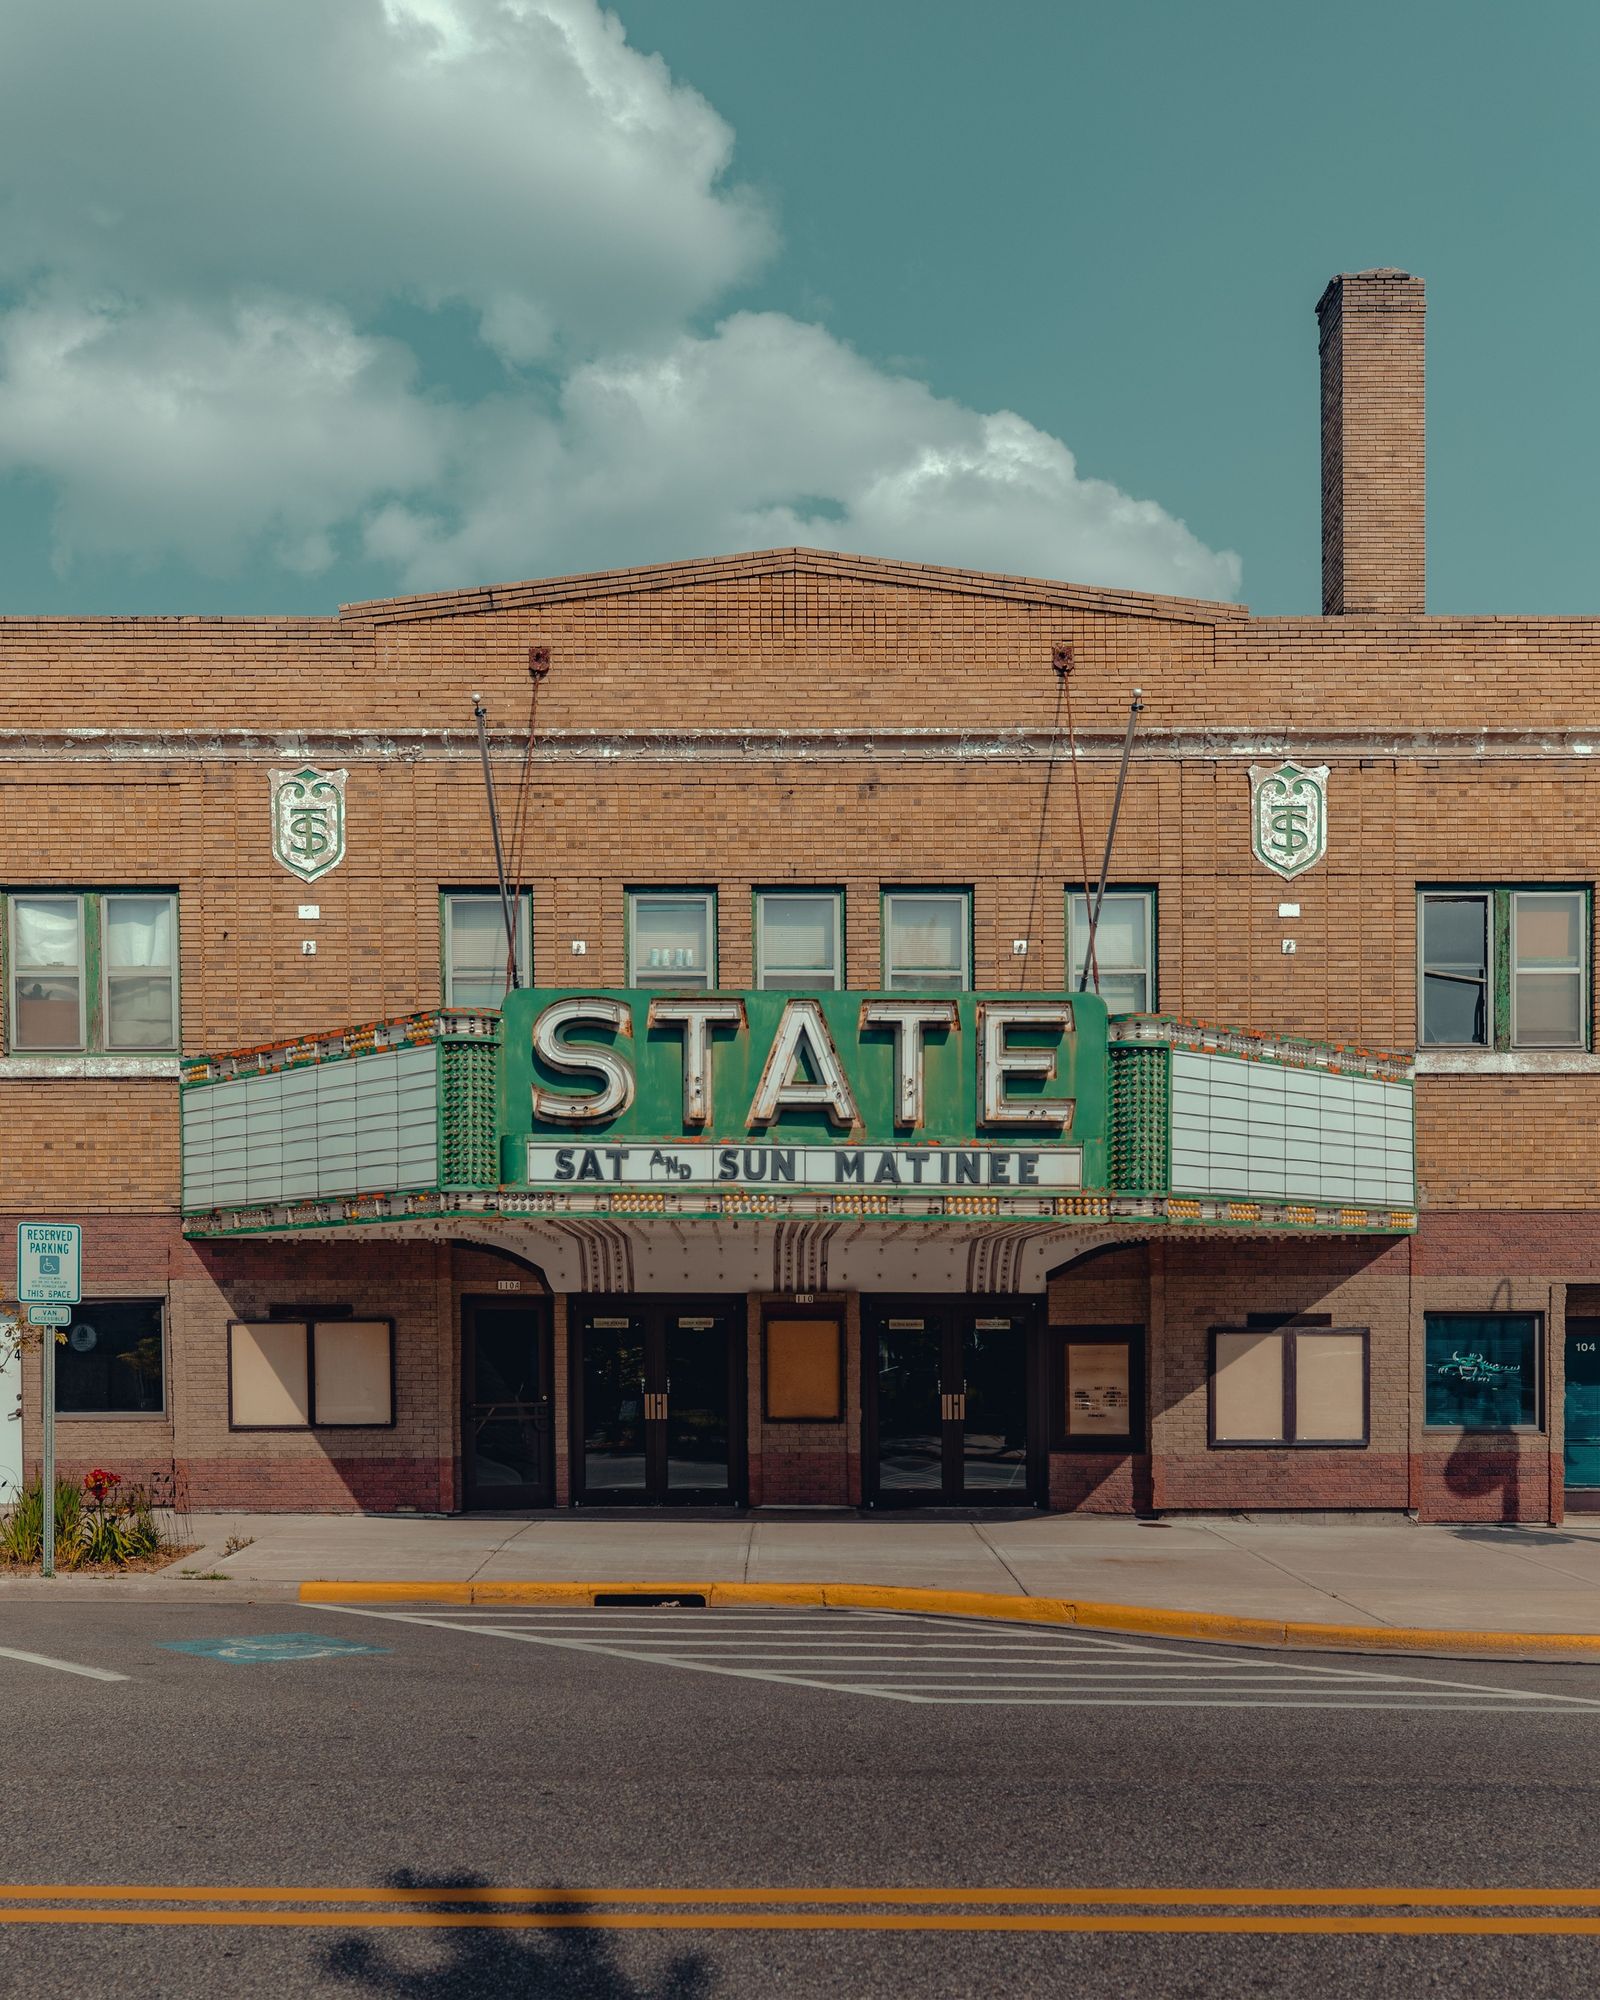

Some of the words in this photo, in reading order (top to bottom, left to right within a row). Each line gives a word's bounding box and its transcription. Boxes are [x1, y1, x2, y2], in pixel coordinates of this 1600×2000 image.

[531, 996, 1077, 1130] STATE
[554, 1149, 629, 1181] SAT
[649, 1149, 692, 1181] AND
[718, 1149, 796, 1181] SUN
[834, 1151, 1040, 1184] MATINEE
[27, 1229, 73, 1242] RESERVED
[30, 1243, 69, 1255] PARKING
[27, 1289, 44, 1298] THIS
[48, 1290, 72, 1299] SPACE
[797, 1295, 813, 1303] 110
[1575, 1342, 1596, 1352] 104
